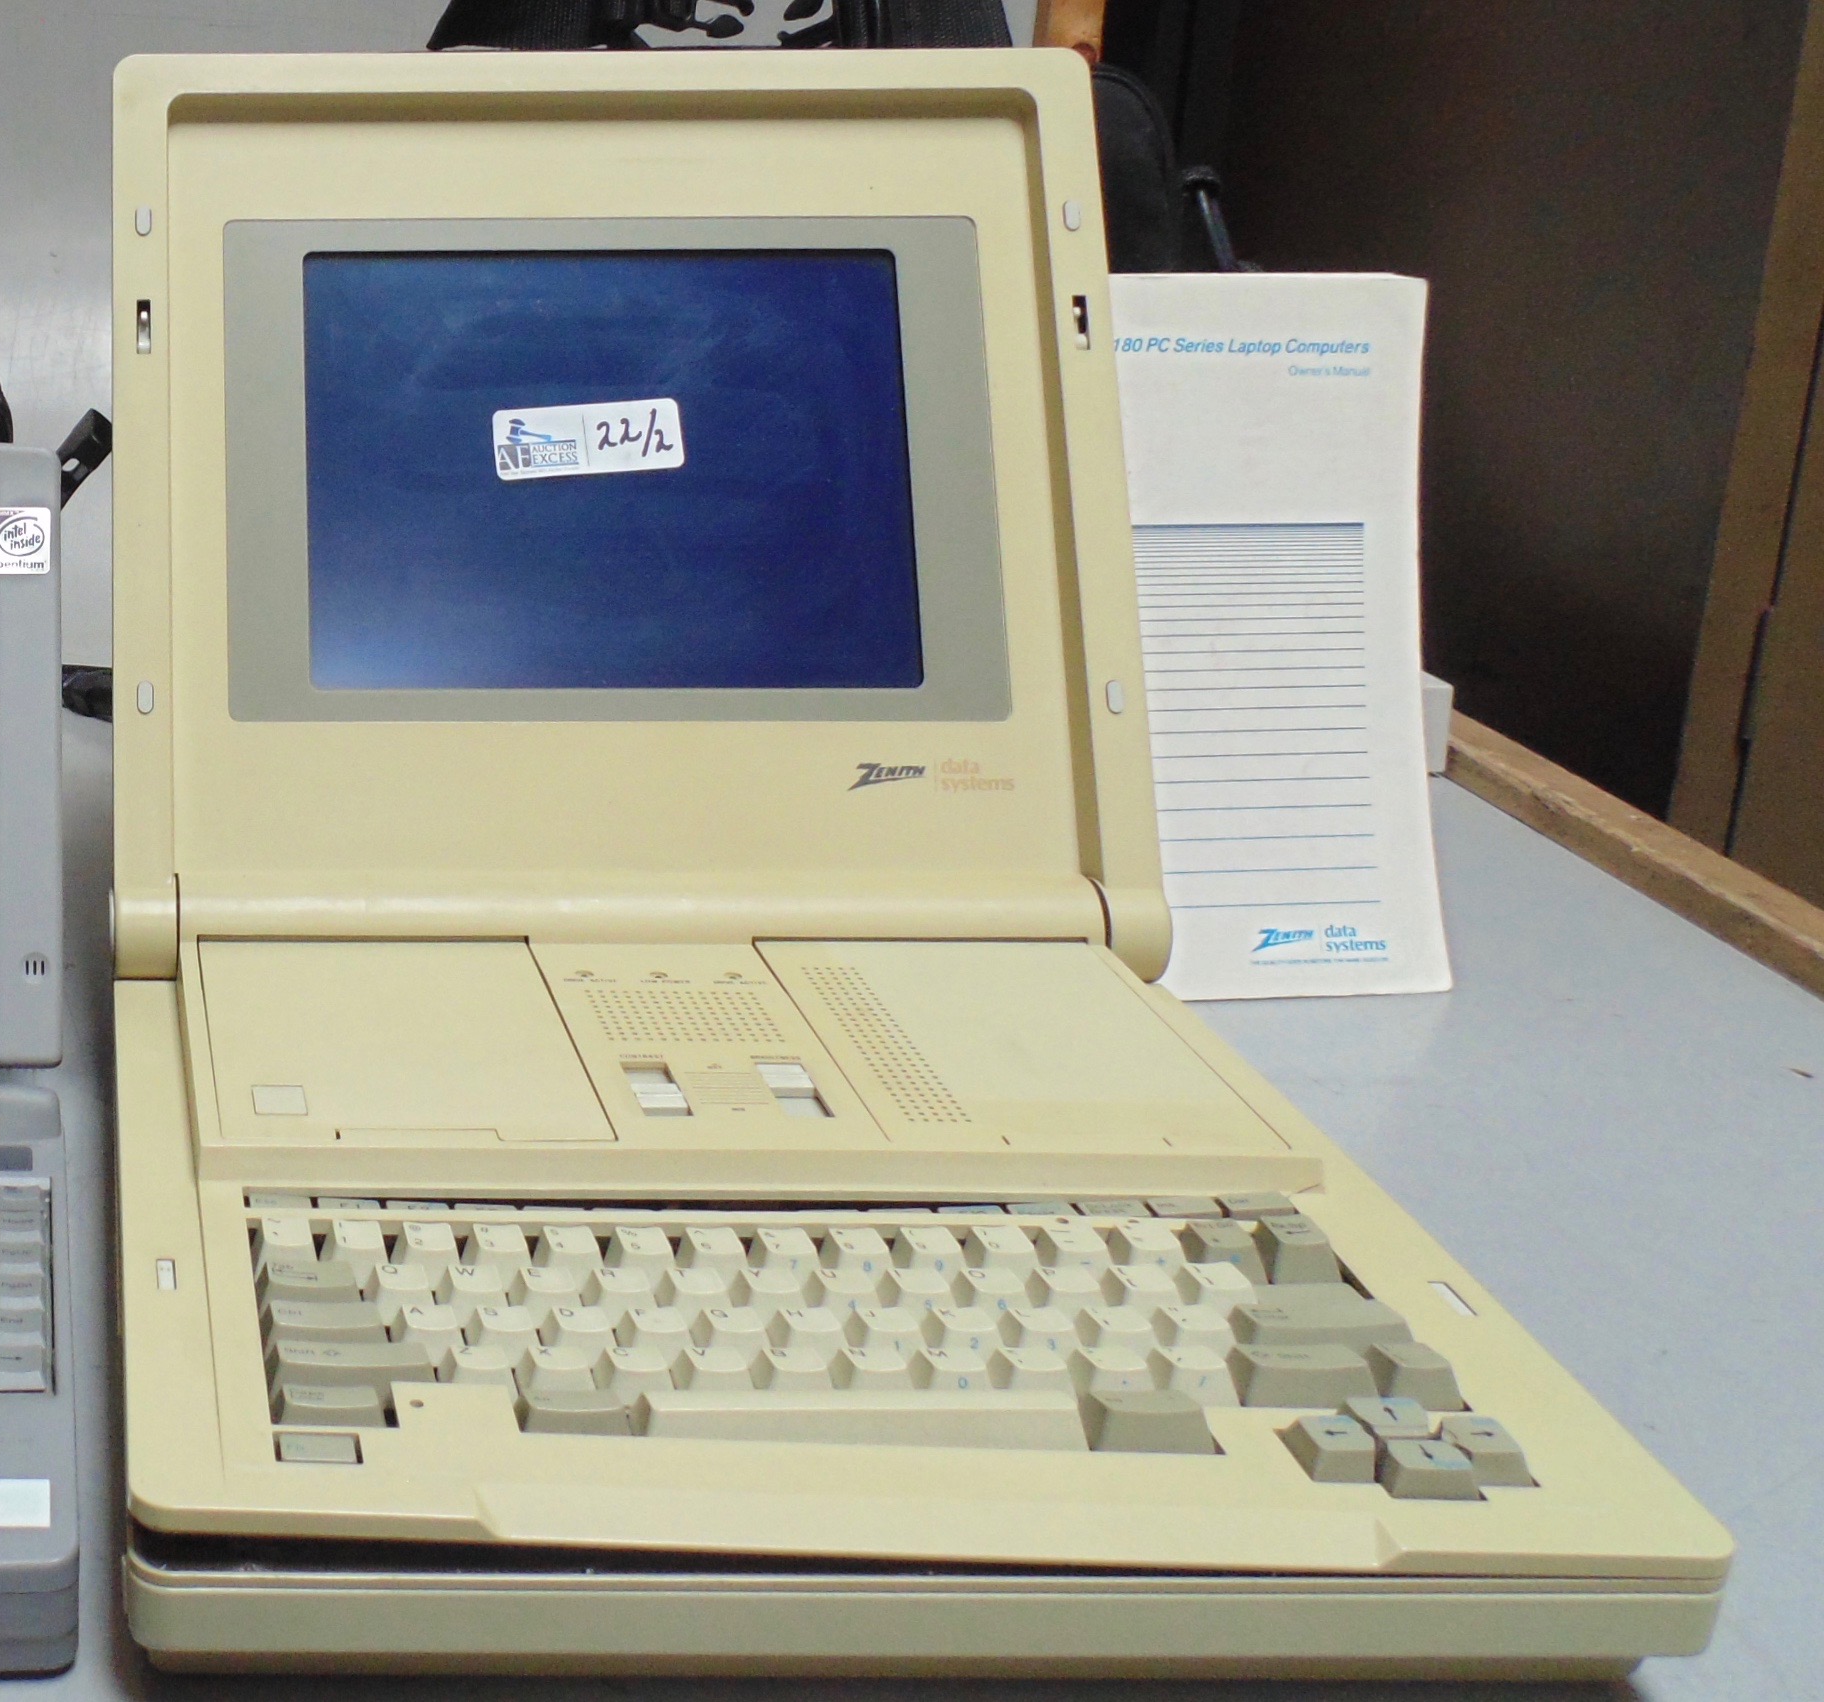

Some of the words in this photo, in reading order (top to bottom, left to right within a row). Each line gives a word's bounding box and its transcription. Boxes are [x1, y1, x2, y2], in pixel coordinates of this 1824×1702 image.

[1146, 337, 1171, 353] PC
[1174, 337, 1224, 353] Series
[1228, 339, 1282, 357] Laptop
[1285, 339, 1371, 356] Computers
[596, 407, 674, 458] 22/2
[531, 443, 577, 454] AUCTION
[532, 451, 578, 465] EXCESS
[4, 522, 26, 541] intel
[10, 534, 41, 550] inside
[940, 758, 980, 774] data
[941, 777, 1015, 793] systems
[1324, 924, 1357, 938] data
[1325, 939, 1387, 953] systems
